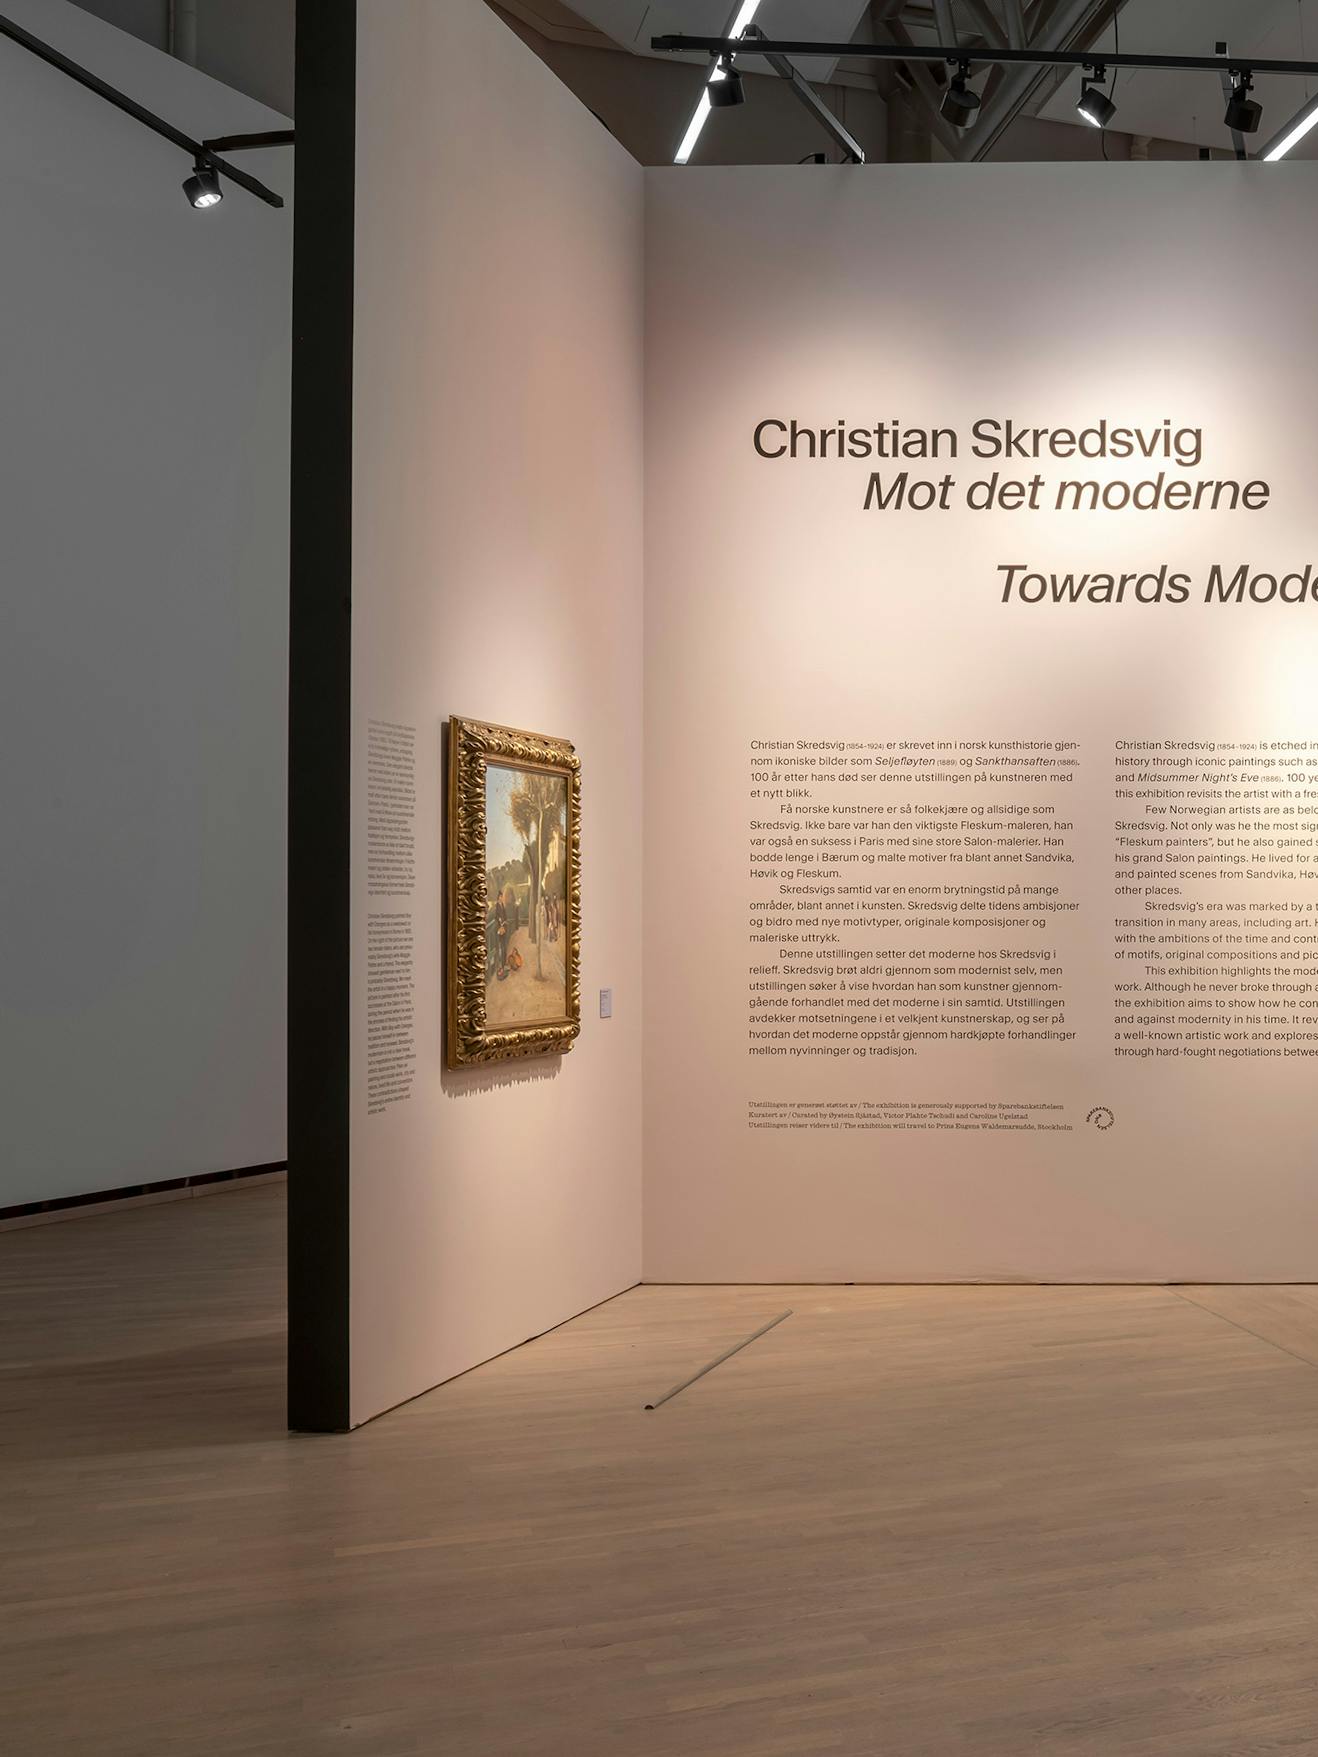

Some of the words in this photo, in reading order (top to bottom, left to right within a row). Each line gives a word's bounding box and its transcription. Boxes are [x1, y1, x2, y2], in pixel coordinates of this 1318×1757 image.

[753, 419, 957, 459] Christian
[971, 419, 1202, 467] Skredsvig
[863, 472, 956, 510] Mot
[966, 472, 1045, 510] det
[1055, 472, 1270, 510] moderne
[997, 565, 1192, 603] Towards
[750, 741, 794, 749] Christian
[796, 741, 845, 751] Skredsvig
[898, 741, 934, 749] skrevet
[937, 741, 952, 749] inn
[959, 741, 986, 749] norsk
[988, 741, 1052, 749] kunsthistorie
[1054, 741, 1081, 751] gjen-
[1115, 741, 1162, 749] Christian
[1164, 741, 1215, 752] Skredsvig
[1259, 742, 1268, 750] is
[1270, 742, 1307, 750] etched
[751, 773, 769, 782] 100
[771, 772, 781, 781] år
[811, 773, 836, 781] hans
[838, 773, 858, 781] død
[879, 773, 912, 781] denne
[914, 774, 971, 783] utstillingen
[974, 772, 987, 783] på
[989, 773, 1047, 782] kunstneren
[1050, 773, 1073, 781] med
[1115, 789, 1134, 798] this
[1135, 789, 1184, 798] exhibition
[1187, 789, 1222, 798] revisits
[1224, 789, 1241, 798] the
[1243, 790, 1268, 798] artist
[1271, 790, 1292, 798] with
[749, 821, 802, 831] Skredsvig.
[805, 821, 825, 829] Ikke
[828, 821, 850, 829] bare
[871, 821, 890, 829] han
[892, 821, 912, 829] den
[915, 821, 958, 832] viktigste
[960, 821, 1051, 830] Fleskum-maleren,
[1054, 821, 1074, 829] han
[1115, 854, 1130, 862] his
[1132, 854, 1163, 864] grand
[1165, 853, 1195, 862] Salon
[1197, 854, 1248, 864] paintings.
[1251, 854, 1266, 862] He
[1268, 854, 1293, 863] lived
[1296, 854, 1310, 862] for
[779, 885, 835, 896] Skredsvigs
[944, 886, 1005, 896] brytningstid
[1007, 884, 1020, 895] på
[1023, 887, 1059, 896] mange
[1114, 918, 1163, 927] transition
[1166, 918, 1175, 926] in
[1178, 920, 1207, 928] many
[1243, 918, 1292, 929] including
[749, 965, 780, 974] relieff.
[783, 965, 833, 976] Skredsvig
[836, 966, 857, 974] brøt
[860, 966, 882, 974] aldri
[885, 966, 931, 976] gjennom
[958, 966, 1011, 974] modernist
[1013, 966, 1037, 975] selv,
[1144, 966, 1166, 975] This
[1168, 967, 1218, 975] exhibition
[1221, 967, 1271, 977] highlights
[1274, 967, 1291, 975] the
[1114, 1015, 1134, 1023] and
[1136, 1015, 1175, 1025] against
[1178, 1015, 1231, 1025] modernity
[1234, 1015, 1244, 1023] in
[1246, 1015, 1261, 1024] his
[1264, 1015, 1289, 1024] time.
[748, 1030, 790, 1038] hvordan
[792, 1030, 809, 1038] det
[812, 1030, 858, 1039] moderne
[860, 1029, 900, 1040] oppstår
[902, 1031, 948, 1041] gjennom
[950, 1031, 1005, 1040] hardkjøpte
[1007, 1030, 1076, 1041] forhandlinger
[1114, 1047, 1154, 1057] through
[1156, 1048, 1216, 1058] hard-fought
[1218, 1048, 1281, 1058] negotiations
